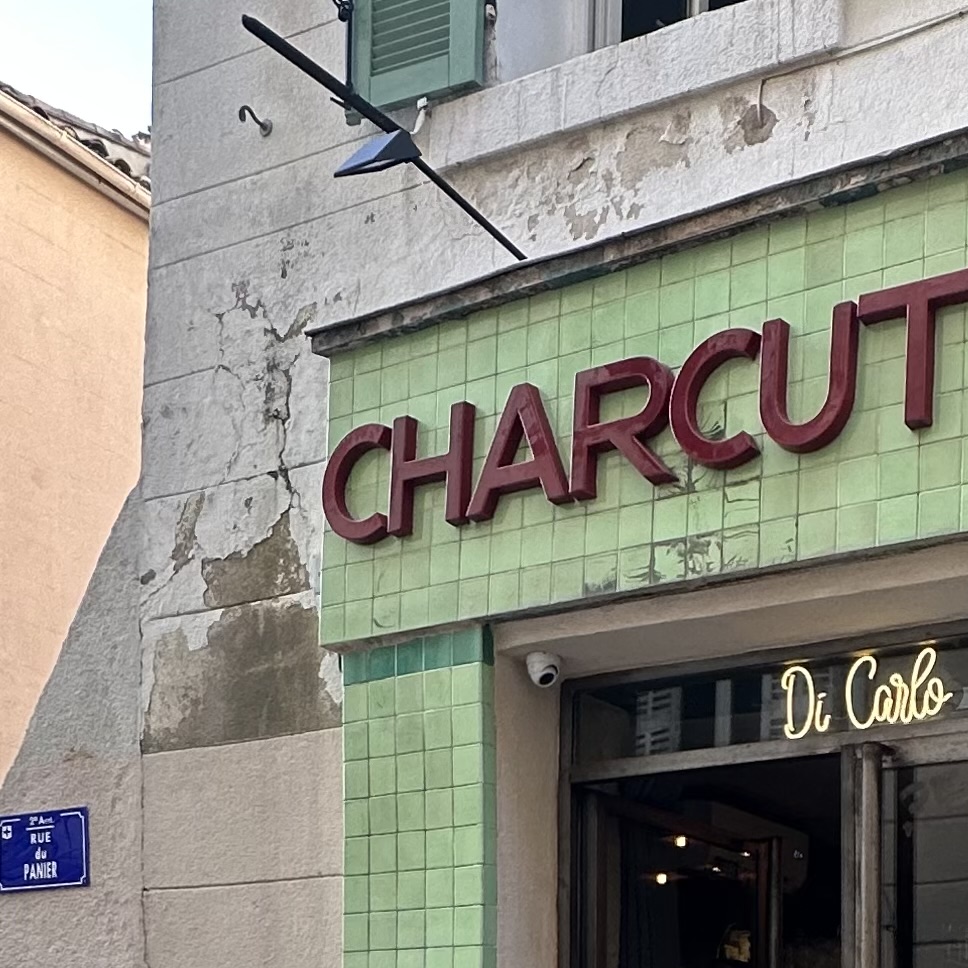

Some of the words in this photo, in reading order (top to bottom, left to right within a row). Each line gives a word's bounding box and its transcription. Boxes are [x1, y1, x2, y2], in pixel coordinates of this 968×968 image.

[780, 665, 832, 740] Di
[845, 646, 954, 730] Carlo
[30, 831, 52, 845] RUE
[34, 846, 48, 860] du
[23, 861, 59, 881] PANIER
